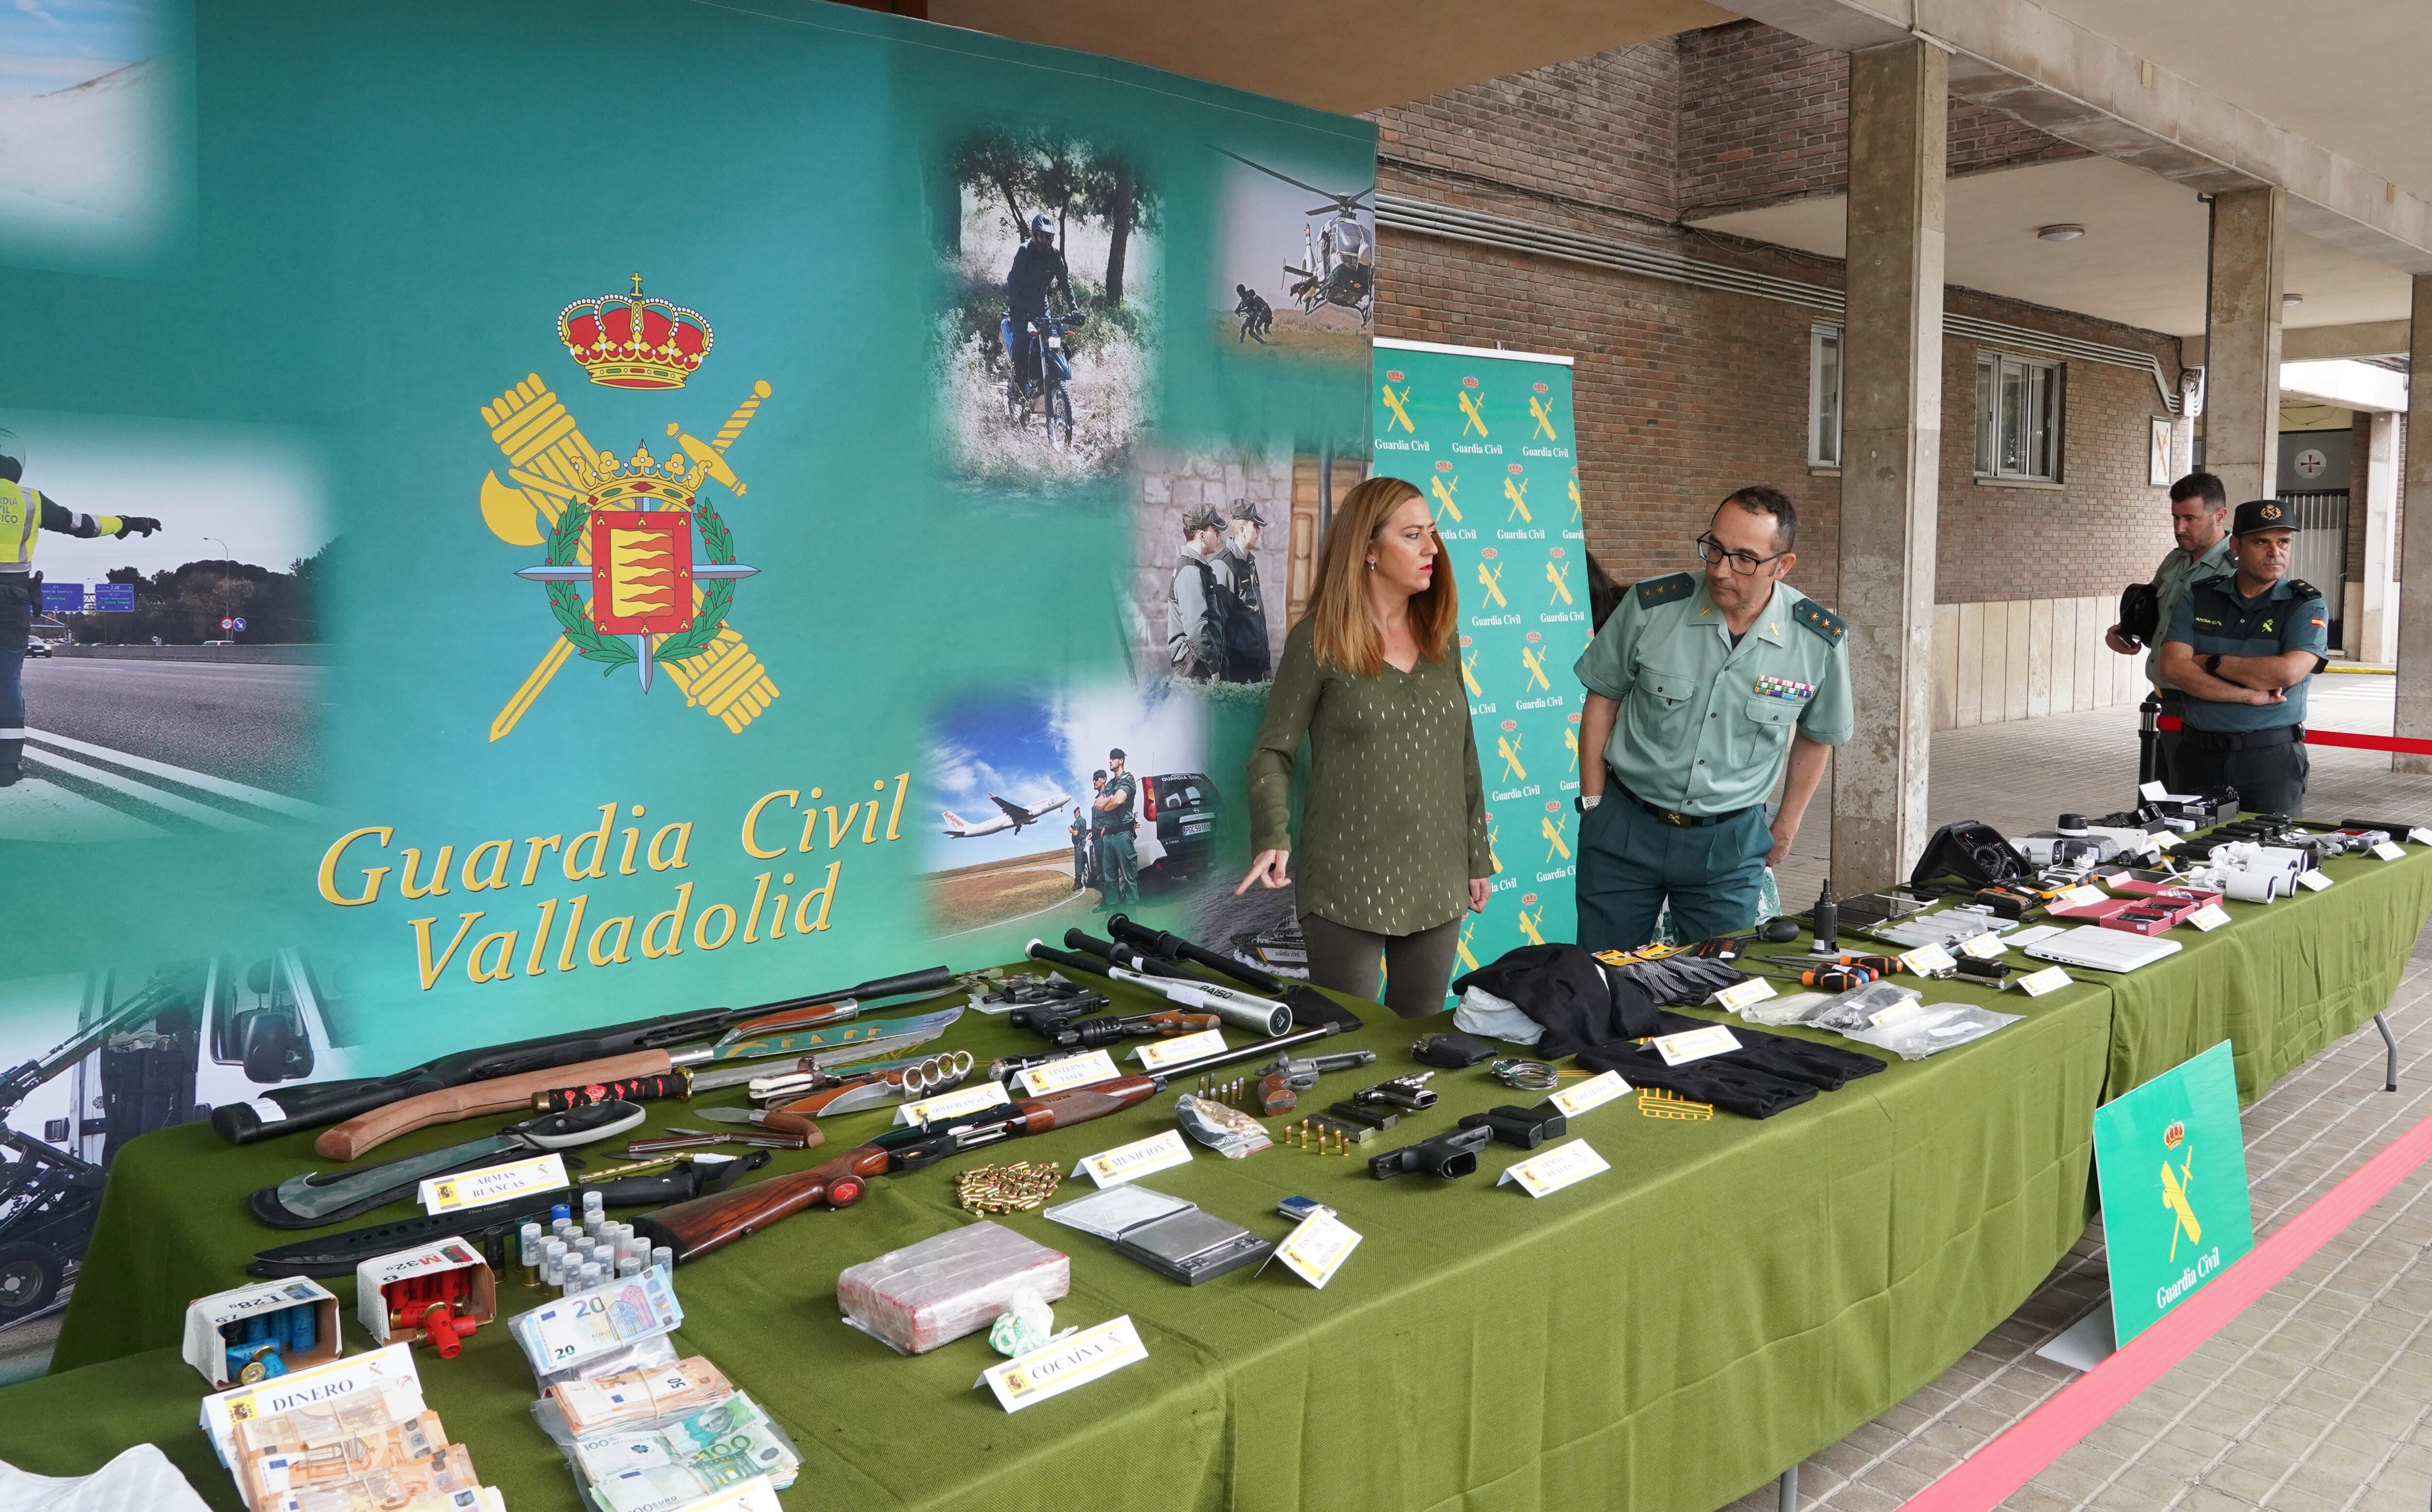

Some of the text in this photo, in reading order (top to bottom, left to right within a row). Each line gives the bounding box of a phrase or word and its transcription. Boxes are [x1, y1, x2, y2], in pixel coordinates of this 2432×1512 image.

[1375, 439, 1430, 451] Guardia Civil
[1452, 443, 1502, 454] Guardia Civil
[1522, 446, 1569, 458] Guardia Civil
[1459, 529, 1477, 539] Civil
[1497, 529, 1545, 539] Guardia Civil
[1472, 614, 1521, 626] Guardia Civil
[1540, 611, 1584, 623] Guardia Civil
[1479, 703, 1496, 714] Civil
[1516, 696, 1563, 710] Guardia Civil
[1492, 784, 1540, 801] Guardia Civil
[317, 772, 911, 907] Guardia Civil
[1537, 868, 1566, 883] Guardia
[1500, 877, 1517, 891] Civil
[408, 861, 841, 991] Valladolid
[1048, 1063, 1086, 1076] LINTERNA
[1059, 1072, 1084, 1083] TASER
[930, 1097, 984, 1114] ARMAS BLANCAS
[1111, 1144, 1165, 1168] MUNICIÓN
[1540, 1156, 1564, 1169] ARMAS
[1546, 1163, 1574, 1178] REALES
[476, 1171, 516, 1186] ARMAS
[473, 1180, 525, 1198] BLANCAS
[418, 1255, 443, 1265] M
[2157, 1246, 2220, 1309] Guardia Civil
[229, 1299, 265, 1309] 28g
[572, 1297, 606, 1318] 20
[591, 1330, 611, 1338] EURO
[554, 1344, 575, 1360] 20
[1032, 1343, 1105, 1380] COCAÍNA
[594, 1375, 627, 1390] 50
[667, 1377, 686, 1389] 50
[272, 1379, 354, 1411] DINERO
[582, 1440, 609, 1451] 100
[696, 1435, 751, 1459] 100
[652, 1495, 678, 1507] EURO
